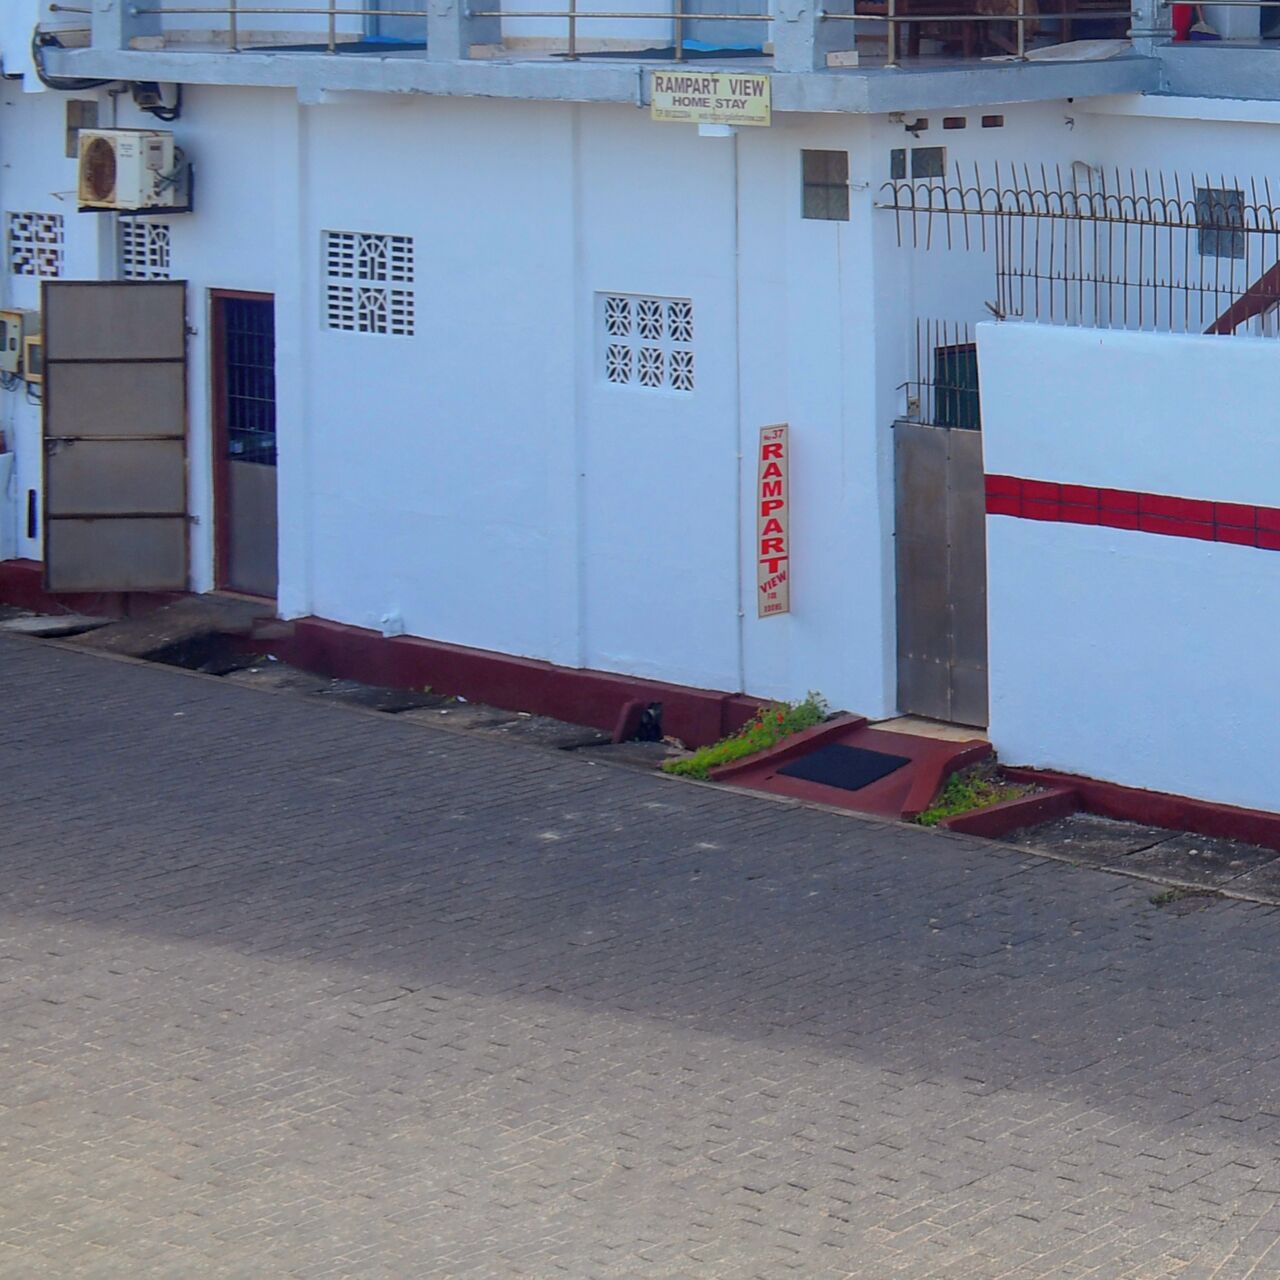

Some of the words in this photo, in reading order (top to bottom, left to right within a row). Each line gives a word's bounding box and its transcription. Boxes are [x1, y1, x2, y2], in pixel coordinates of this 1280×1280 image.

[655, 76, 720, 95] RAMPART
[729, 79, 765, 97] VIEW
[672, 96, 711, 108] HOME
[715, 98, 748, 109] STAY
[759, 442, 789, 574] RAMPART
[760, 570, 787, 594] VIEW
